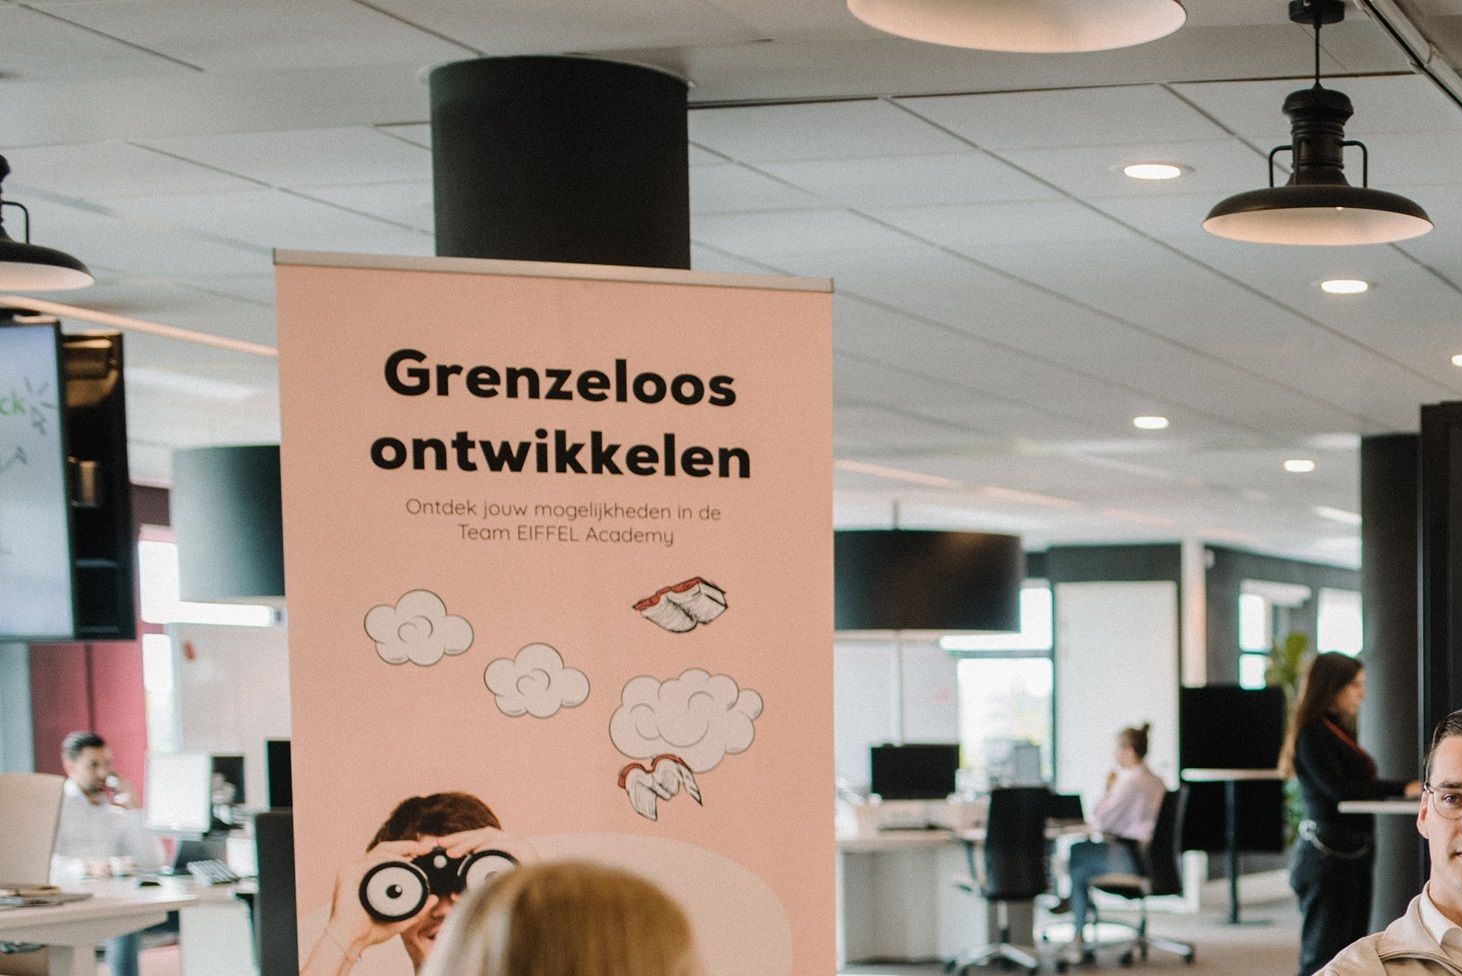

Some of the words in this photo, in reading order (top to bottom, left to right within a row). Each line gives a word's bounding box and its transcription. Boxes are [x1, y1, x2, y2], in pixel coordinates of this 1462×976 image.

[384, 348, 737, 406] Grenzeloos
[370, 428, 751, 479] ontwikkelen
[405, 498, 477, 516] Ontdek
[482, 500, 528, 519] jouw
[534, 503, 671, 522] mogelijkheden
[677, 504, 693, 519] in
[698, 503, 721, 520] de
[459, 523, 511, 541] Team
[517, 524, 579, 542] EIFFEL
[585, 525, 675, 546] Academy
